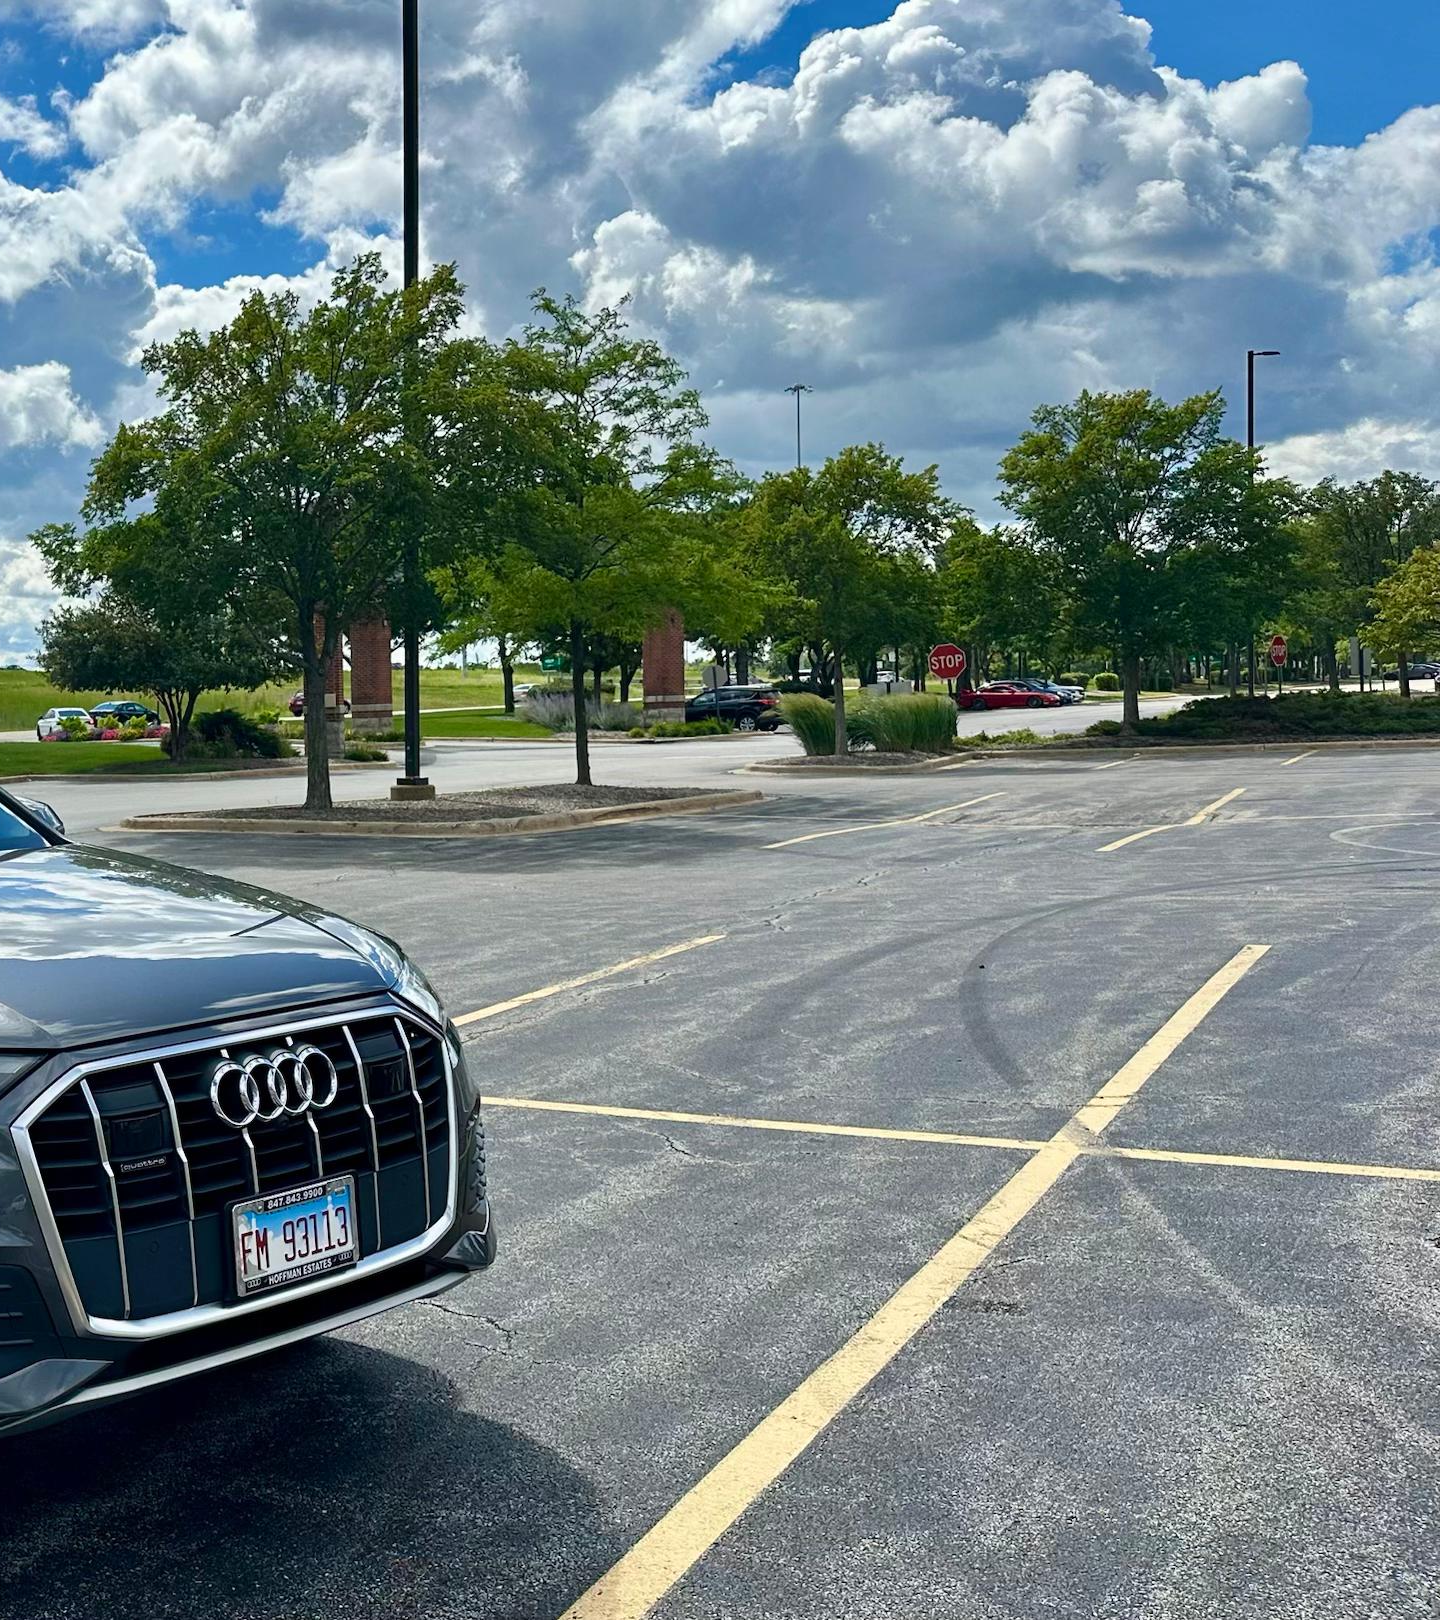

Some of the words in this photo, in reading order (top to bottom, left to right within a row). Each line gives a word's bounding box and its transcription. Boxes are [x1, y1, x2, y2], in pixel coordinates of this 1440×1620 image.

[931, 654, 963, 670] STOP
[266, 1187, 323, 1209] 847.843.9900
[241, 1227, 270, 1274] FM
[282, 1206, 349, 1262] 93113
[268, 1268, 302, 1285] HOFFMAN
[303, 1257, 333, 1278] ESTATES
